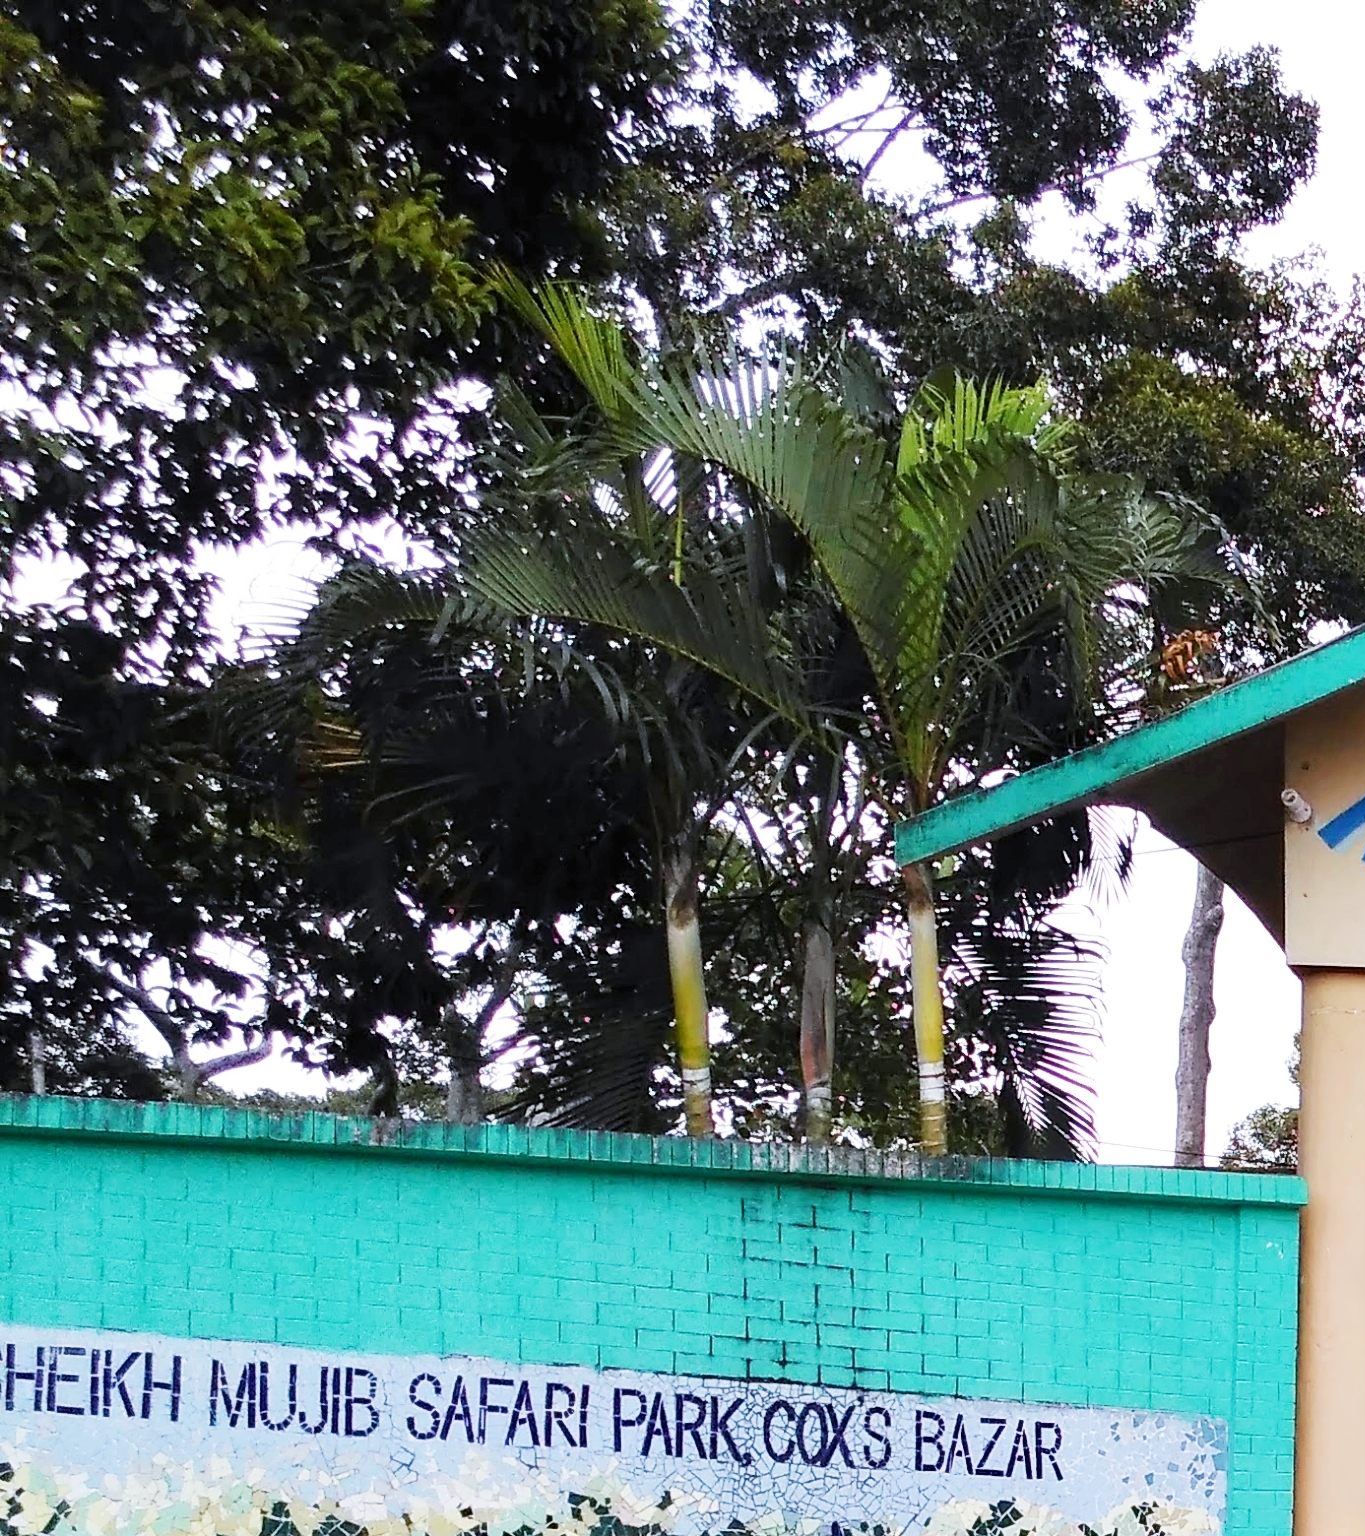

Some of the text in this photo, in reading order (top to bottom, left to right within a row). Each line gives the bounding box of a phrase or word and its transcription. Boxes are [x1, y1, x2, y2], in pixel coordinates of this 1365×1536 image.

[0, 1343, 183, 1422] HEIKH
[209, 1362, 379, 1438] MUJIB
[407, 1374, 588, 1447] SAFARI
[914, 1409, 1064, 1482] BAZAR
